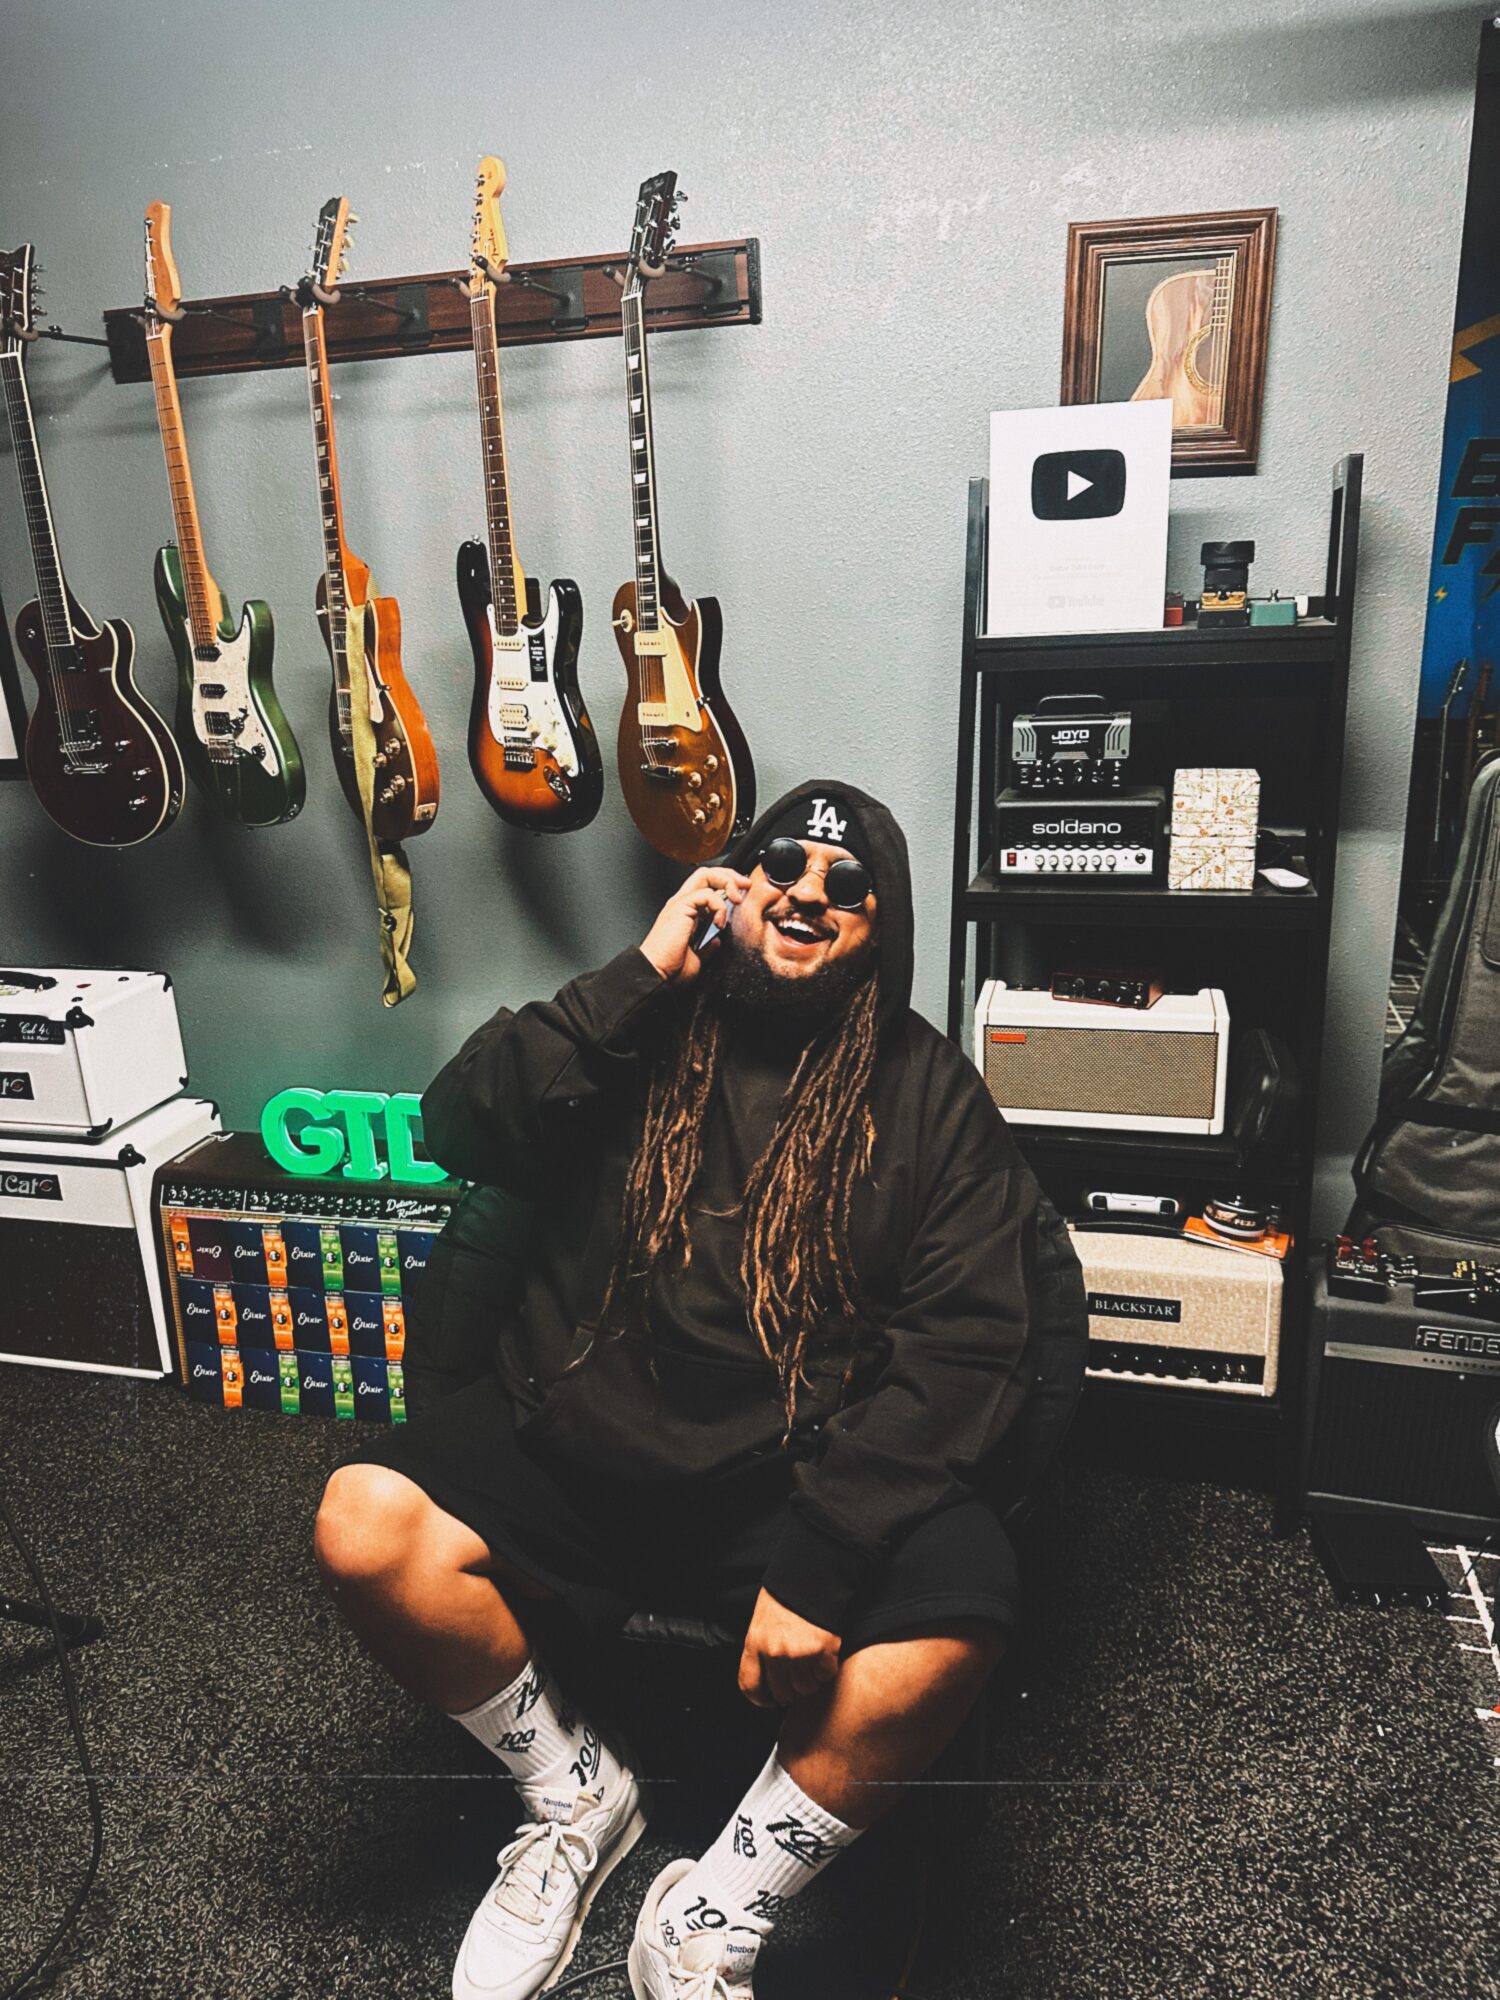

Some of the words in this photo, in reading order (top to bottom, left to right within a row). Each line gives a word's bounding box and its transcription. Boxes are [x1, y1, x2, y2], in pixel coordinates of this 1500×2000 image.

[1051, 729, 1090, 741] JOYO
[806, 798, 847, 842] LA
[1032, 819, 1122, 834] soldano
[234, 1245, 259, 1259] Elixir
[291, 1246, 316, 1260] Elixir
[347, 1250, 374, 1265] Elixir
[186, 1302, 211, 1316] Elixir
[241, 1307, 267, 1321] Elixir
[1095, 1299, 1175, 1317] BLACKSTAR
[297, 1312, 323, 1326] Elixir
[352, 1316, 379, 1331] Elixir
[193, 1364, 218, 1378] Elixir
[249, 1370, 275, 1384] Elixir
[303, 1375, 328, 1390] Elixir
[357, 1381, 384, 1396] Elixir
[495, 1728, 537, 1749] 100
[568, 1726, 597, 1787] 100
[542, 1797, 573, 1809] Reebok
[735, 1813, 758, 1859] 100
[659, 1919, 681, 1947] 100
[726, 1943, 756, 1954] Reebok
